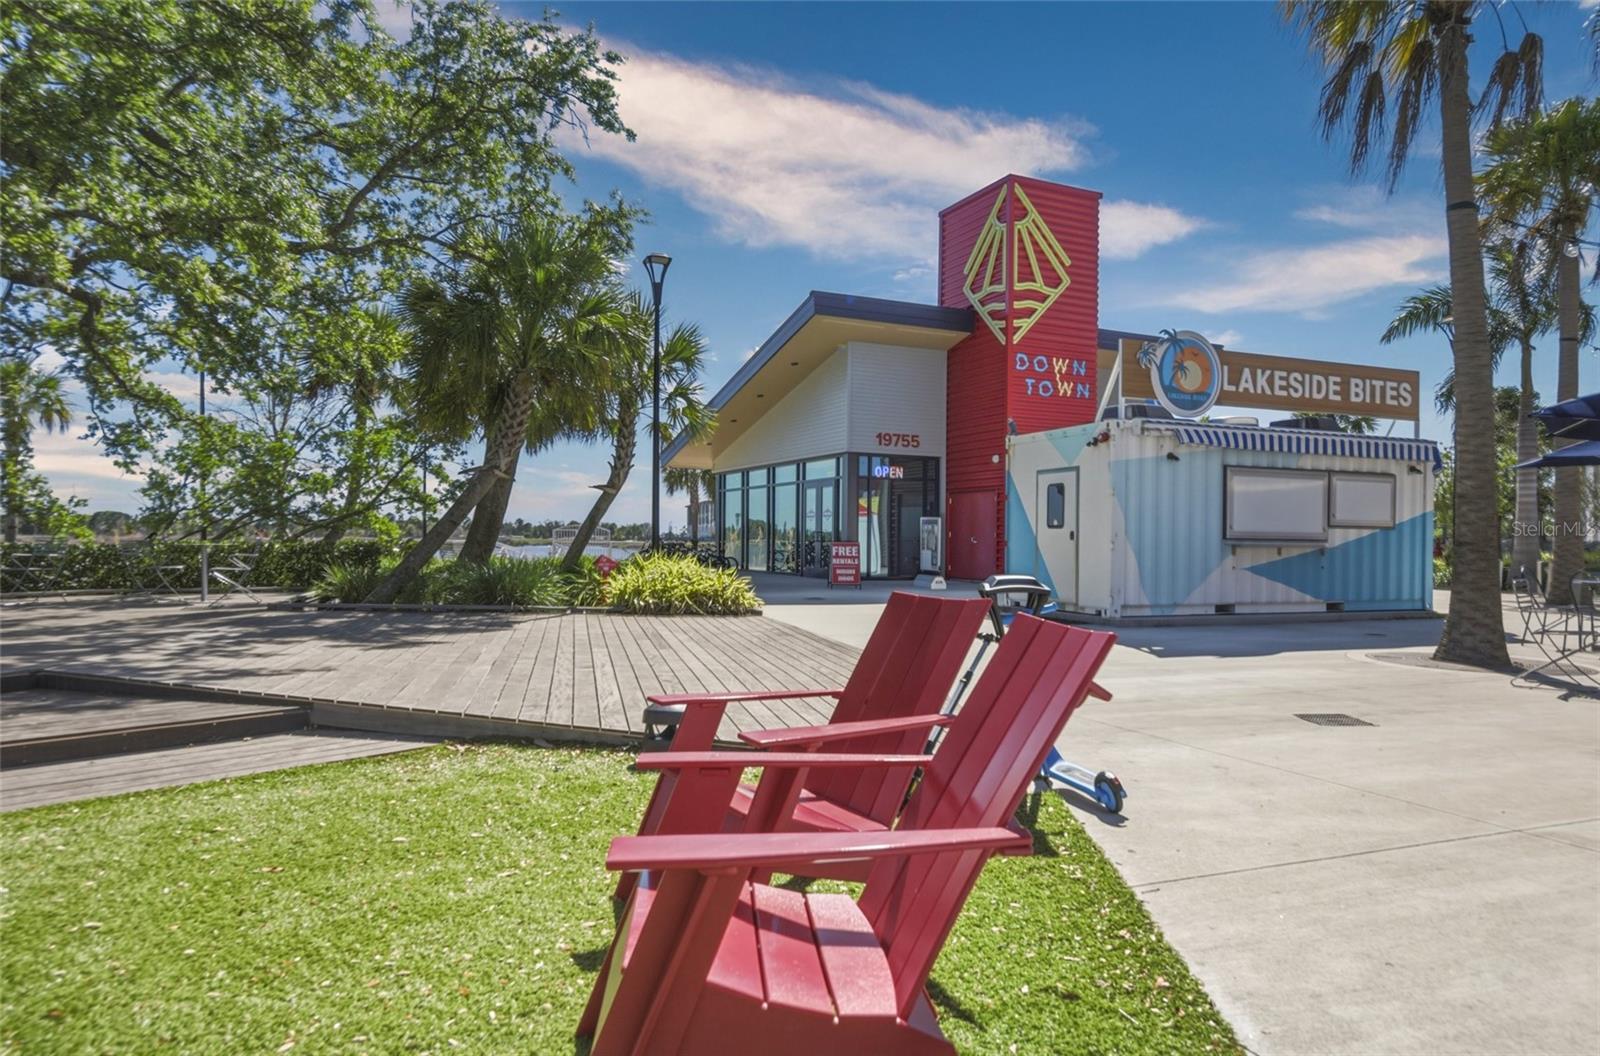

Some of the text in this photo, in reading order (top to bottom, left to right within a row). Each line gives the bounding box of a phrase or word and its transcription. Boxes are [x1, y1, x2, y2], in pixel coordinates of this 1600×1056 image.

[1016, 352, 1087, 376] DOWN
[1025, 378, 1090, 398] TOWN
[1223, 365, 1412, 407] LAKESIDE BITES
[876, 432, 920, 448] 19755
[874, 465, 904, 479] OPEN
[832, 546, 859, 557] FREE
